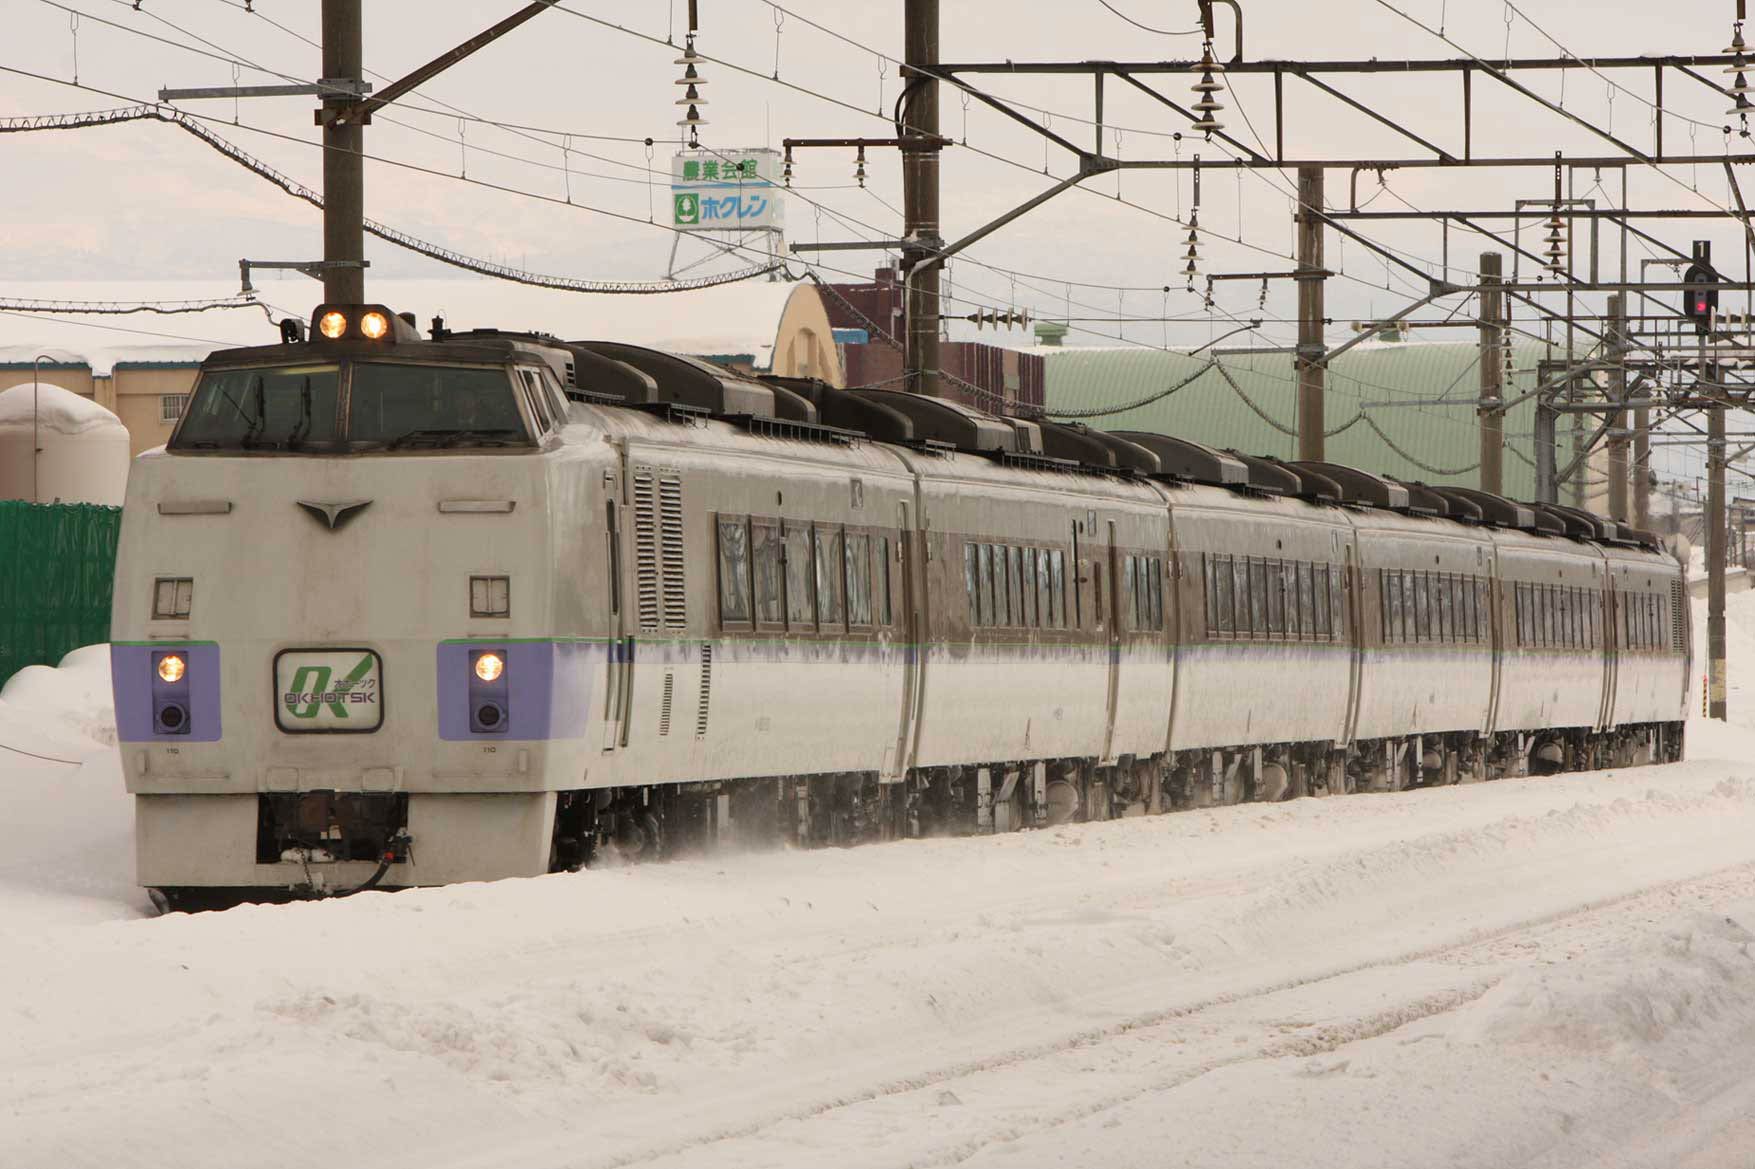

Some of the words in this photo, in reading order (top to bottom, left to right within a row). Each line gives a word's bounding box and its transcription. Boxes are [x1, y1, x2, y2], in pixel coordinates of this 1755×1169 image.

[701, 195, 768, 219] ホクレン
[1698, 241, 1705, 258] 1
[284, 692, 376, 704] OKHOTSK
